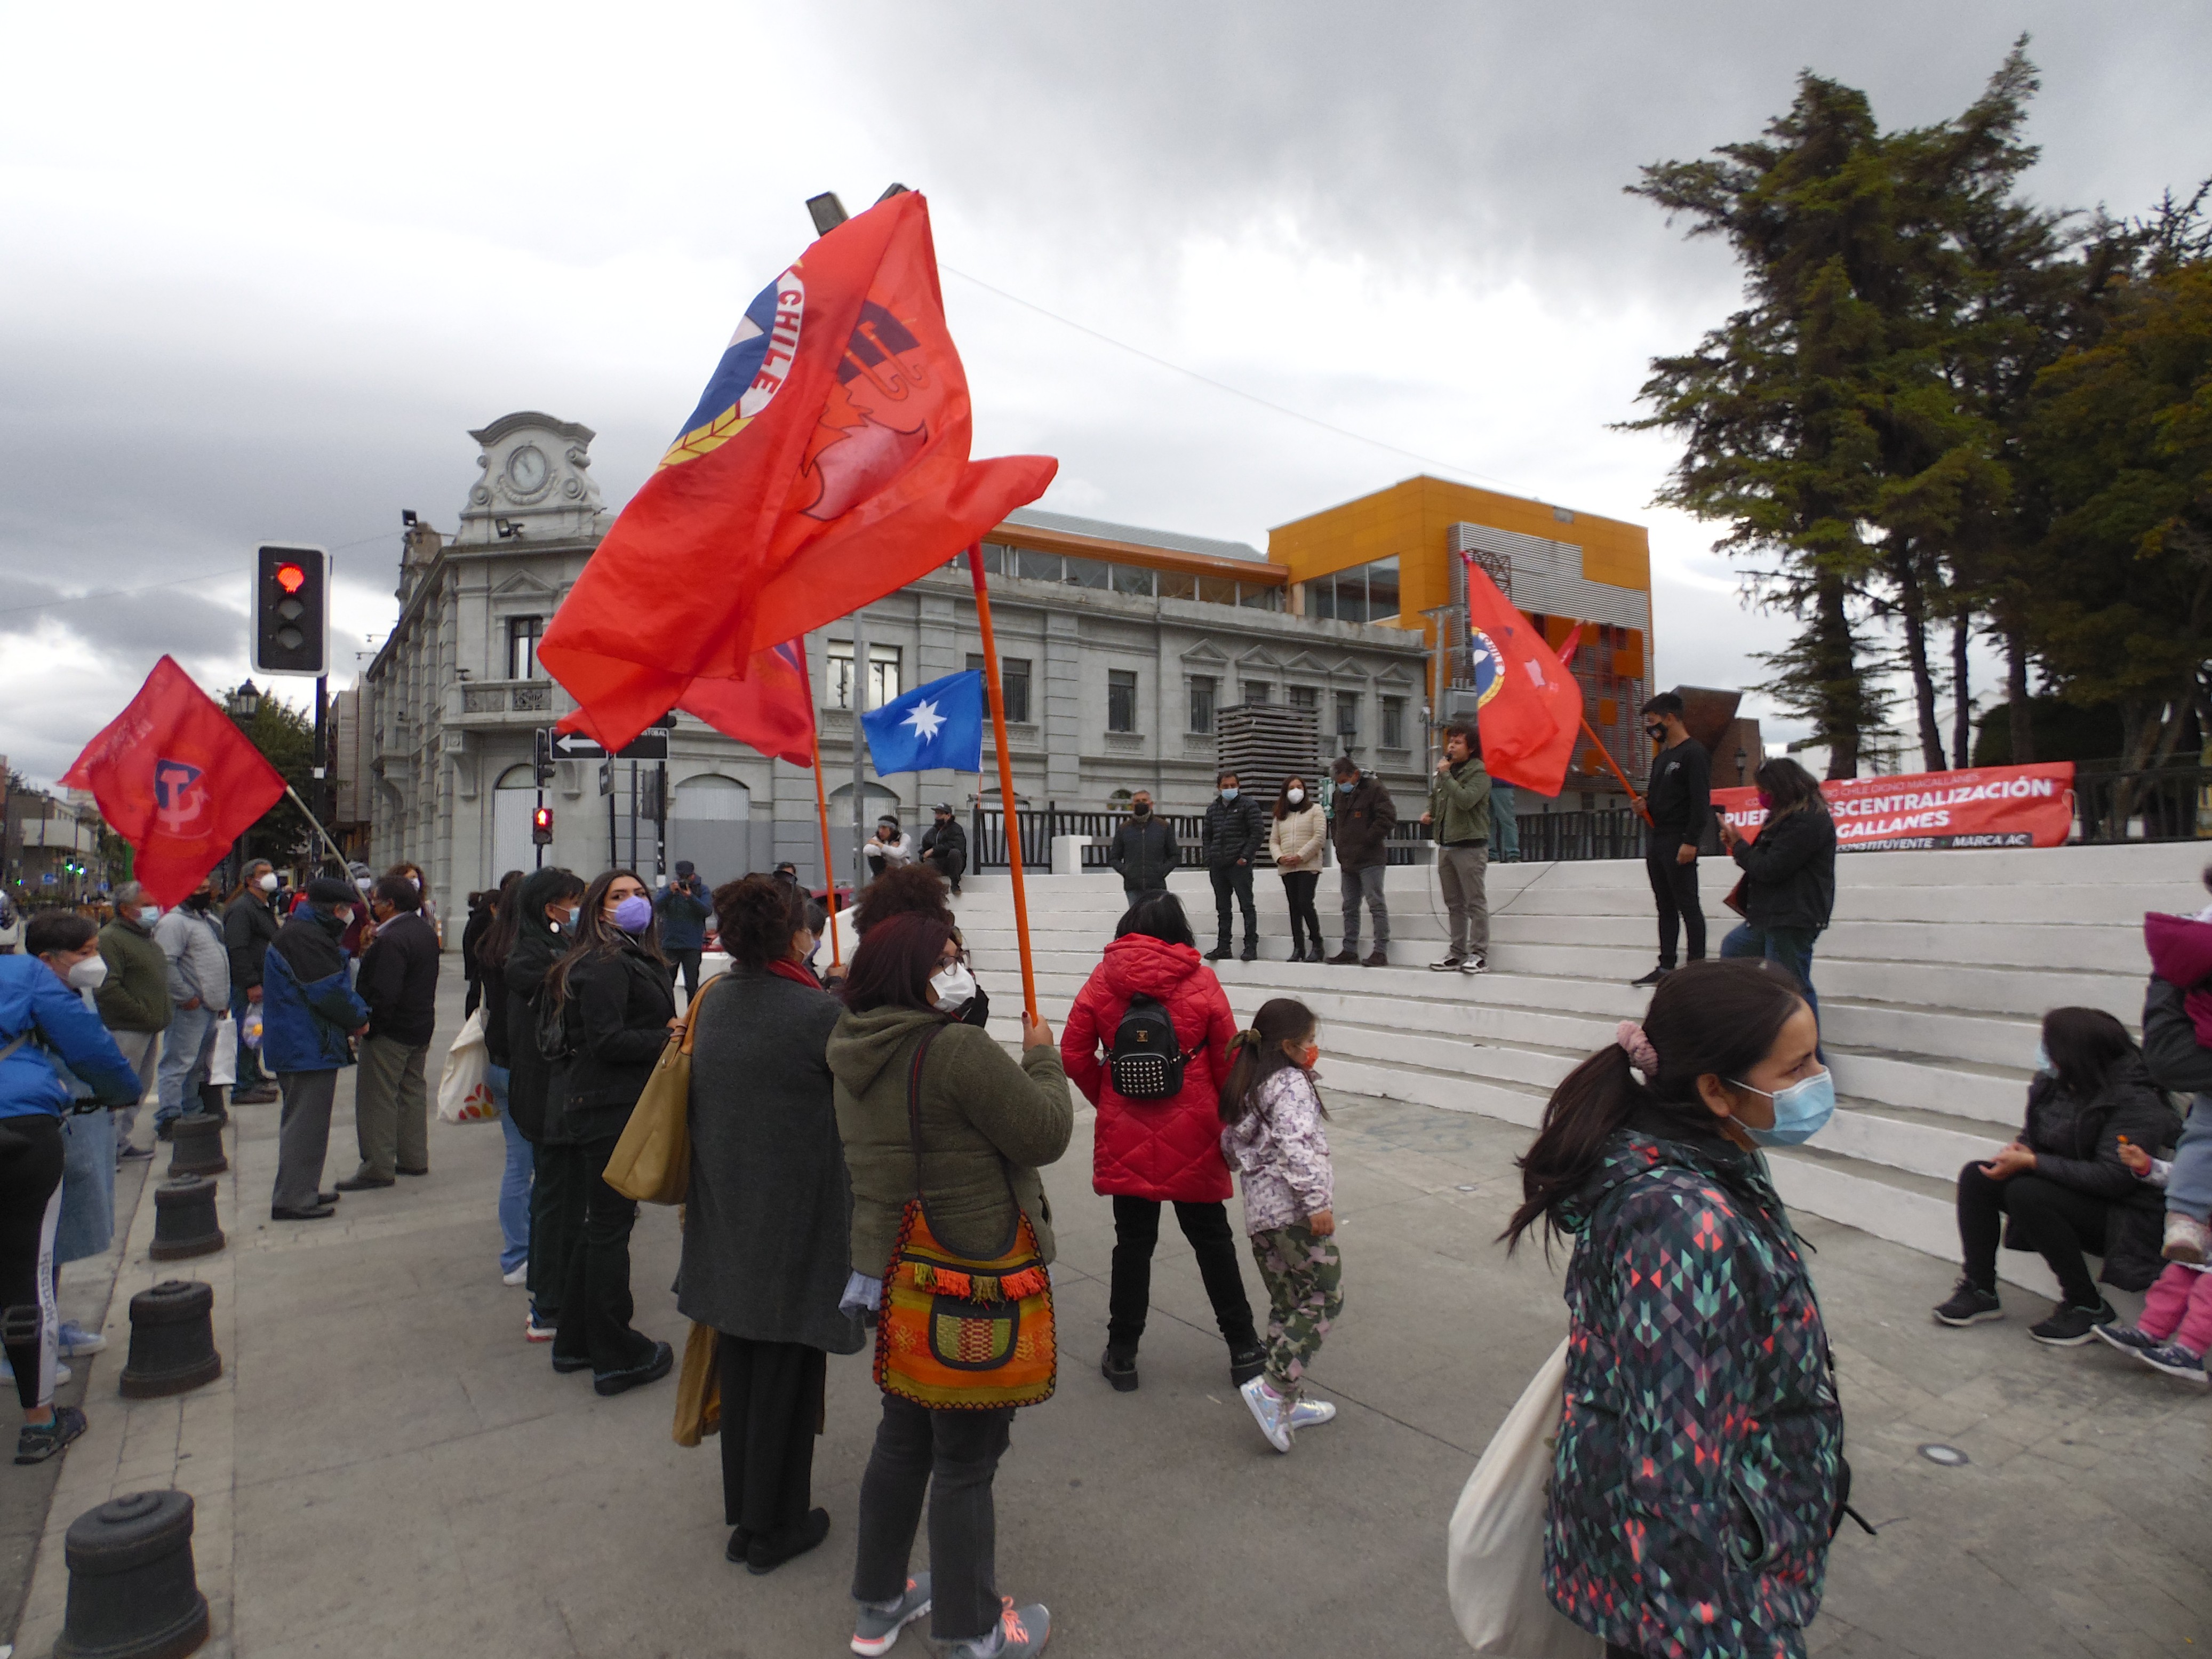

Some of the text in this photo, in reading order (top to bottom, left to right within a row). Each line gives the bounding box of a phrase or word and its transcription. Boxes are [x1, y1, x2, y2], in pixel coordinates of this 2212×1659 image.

[751, 290, 802, 394] CHILE
[1483, 637, 1505, 667] CHILE
[1952, 835, 2003, 848] MARCA
[2005, 834, 2028, 846] AC
